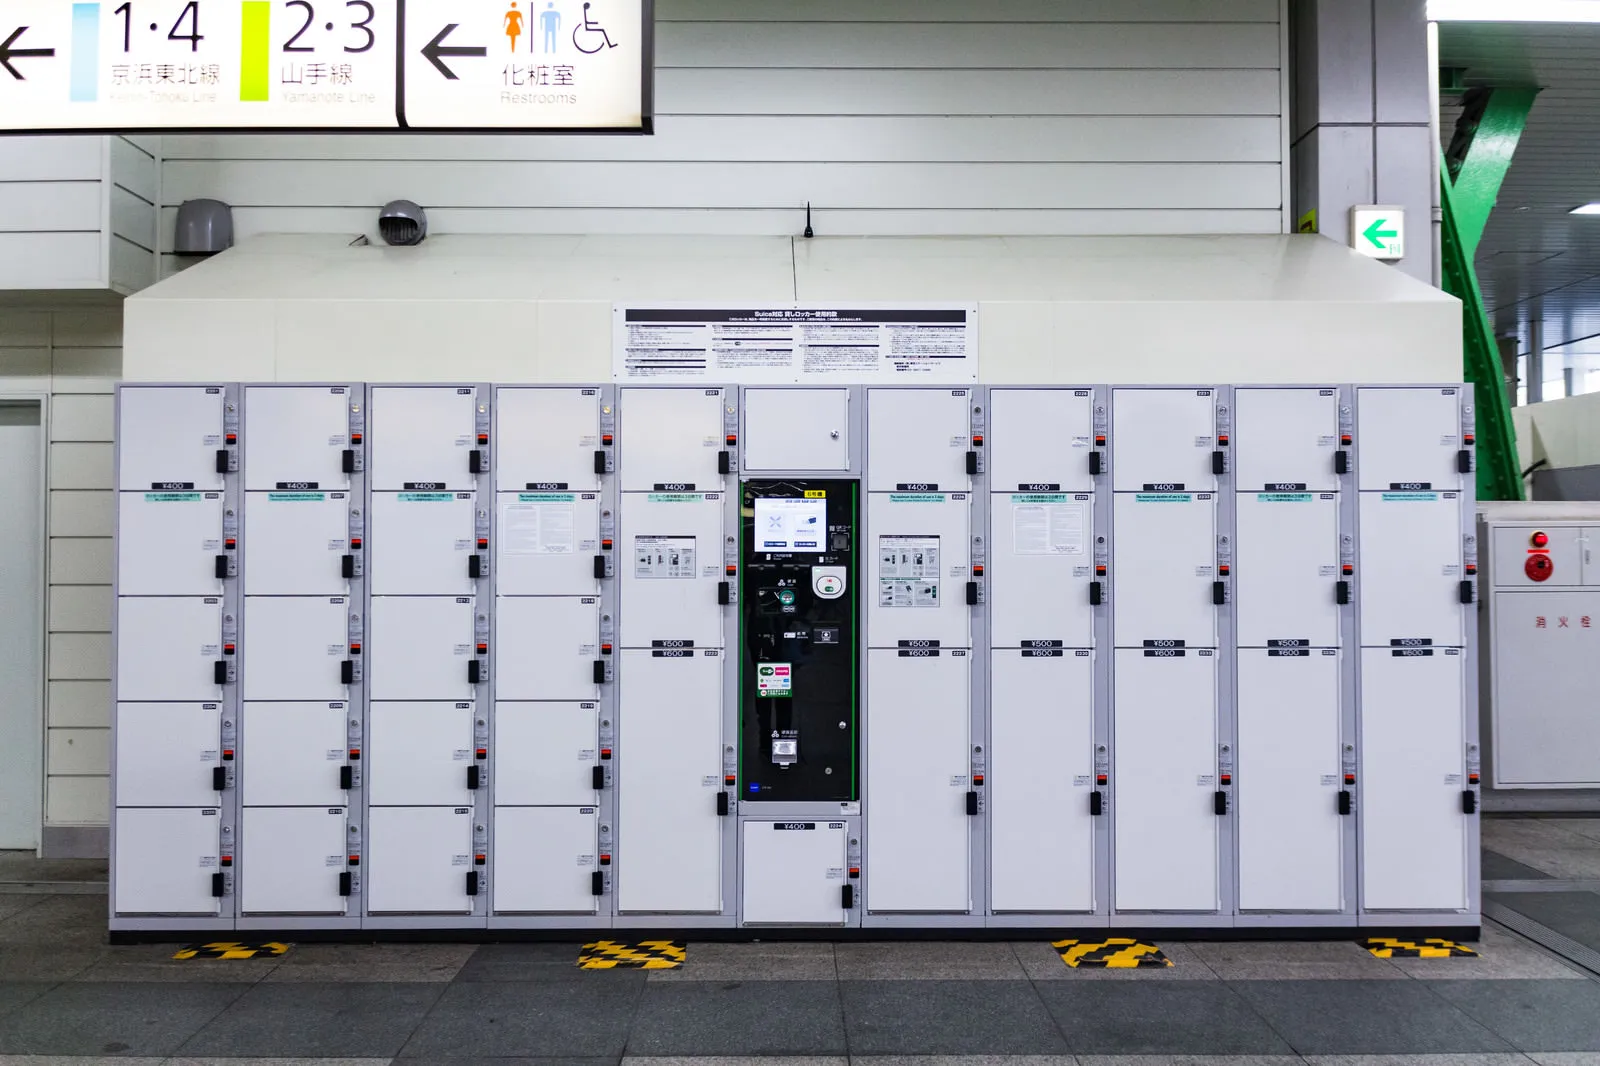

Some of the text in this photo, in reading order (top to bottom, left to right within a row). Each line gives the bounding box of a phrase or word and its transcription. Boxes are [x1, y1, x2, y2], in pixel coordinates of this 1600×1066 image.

[111, 62, 220, 85] 京浜東北線
[281, 62, 353, 85] 山手線
[502, 64, 574, 86] 化粧室
[284, 91, 376, 103] Yamanote Line
[500, 91, 577, 104] Restrooms
[1536, 616, 1591, 628] 消火栓
